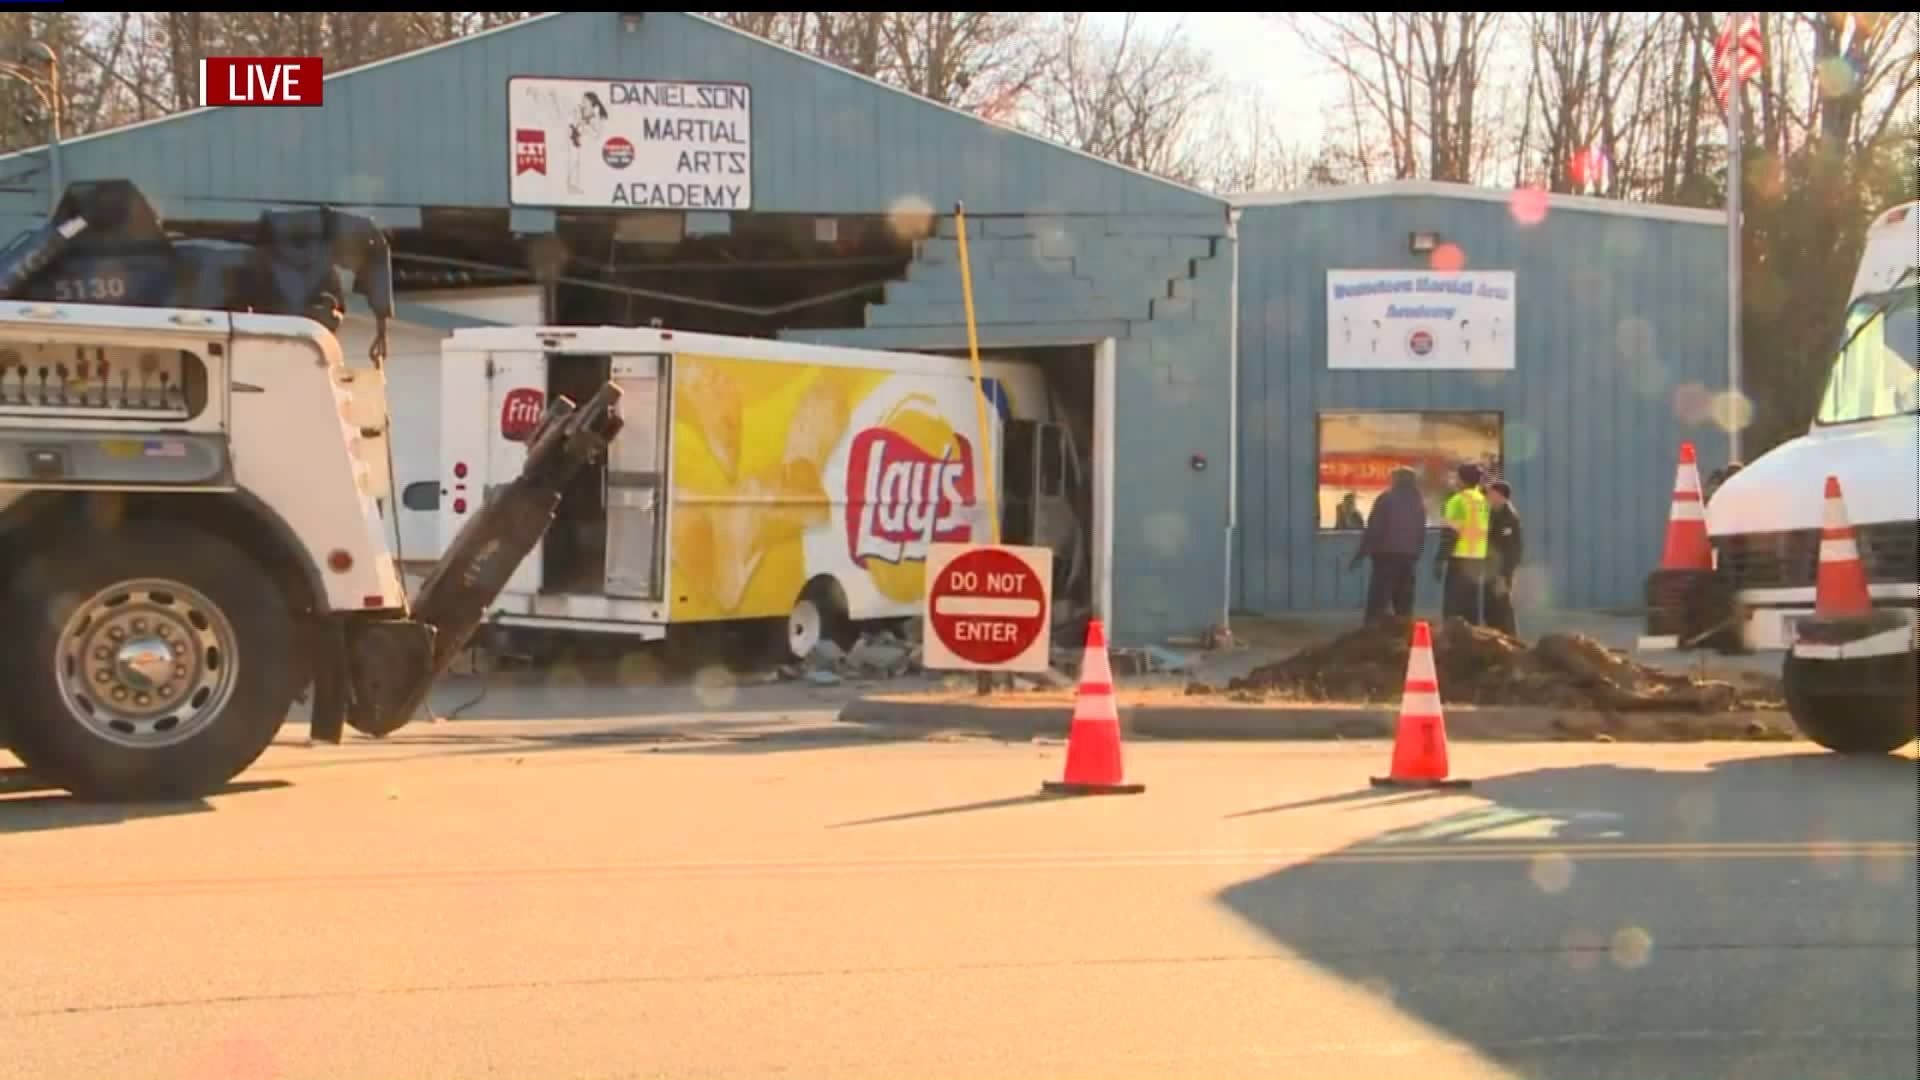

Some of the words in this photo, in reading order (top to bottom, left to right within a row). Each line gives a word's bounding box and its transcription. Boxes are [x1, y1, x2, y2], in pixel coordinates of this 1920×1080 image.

[609, 83, 745, 110] DANIELSON
[643, 117, 745, 144] MARTIAL
[677, 150, 745, 174] ARTS
[611, 183, 741, 208] ACADEMY
[55, 278, 126, 300] 5130
[856, 440, 973, 565] Lay's
[950, 571, 977, 591] DO
[987, 573, 1026, 593] NOT
[955, 622, 1018, 642] ENTER
